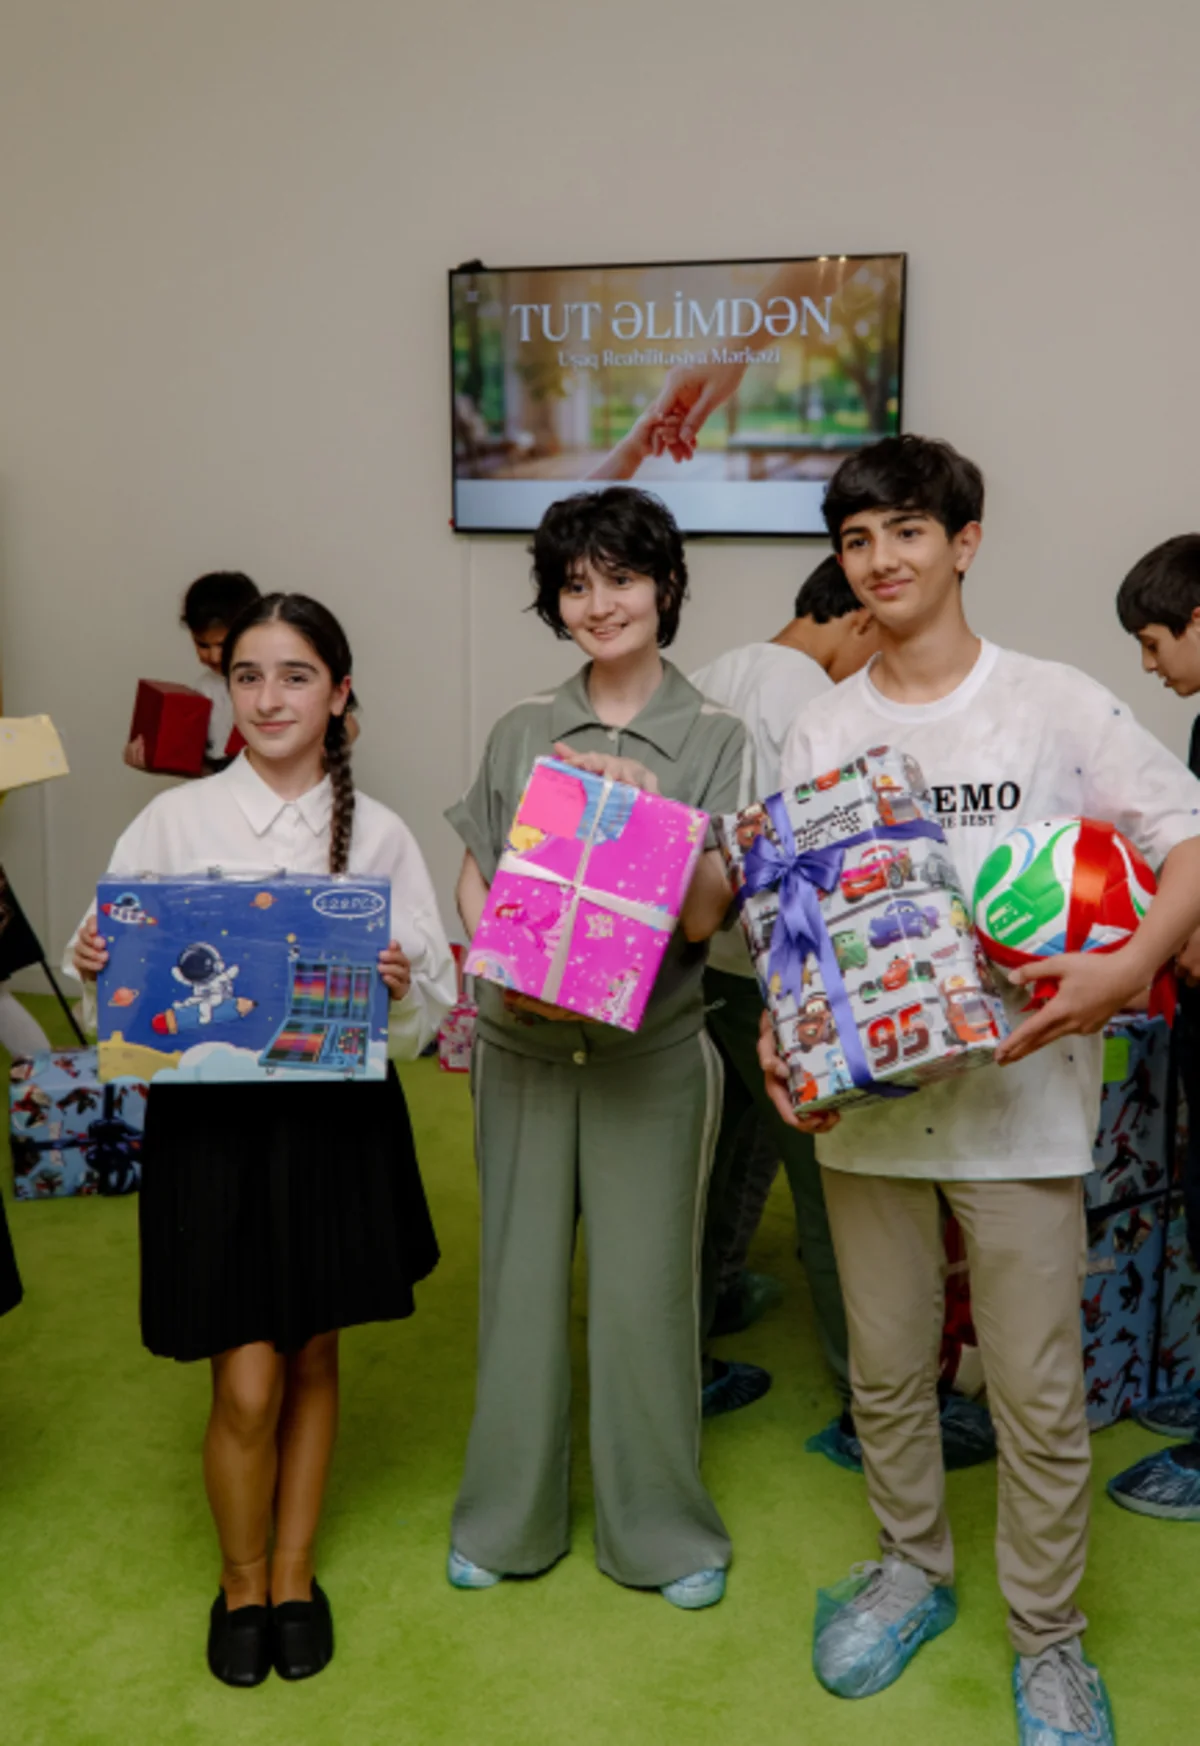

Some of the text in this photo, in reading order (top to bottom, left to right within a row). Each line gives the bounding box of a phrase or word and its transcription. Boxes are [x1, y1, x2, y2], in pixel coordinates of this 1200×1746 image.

[510, 290, 833, 342] TUT ƏLİMDƏN
[931, 780, 1021, 813] EMO
[867, 1001, 930, 1068] 95
